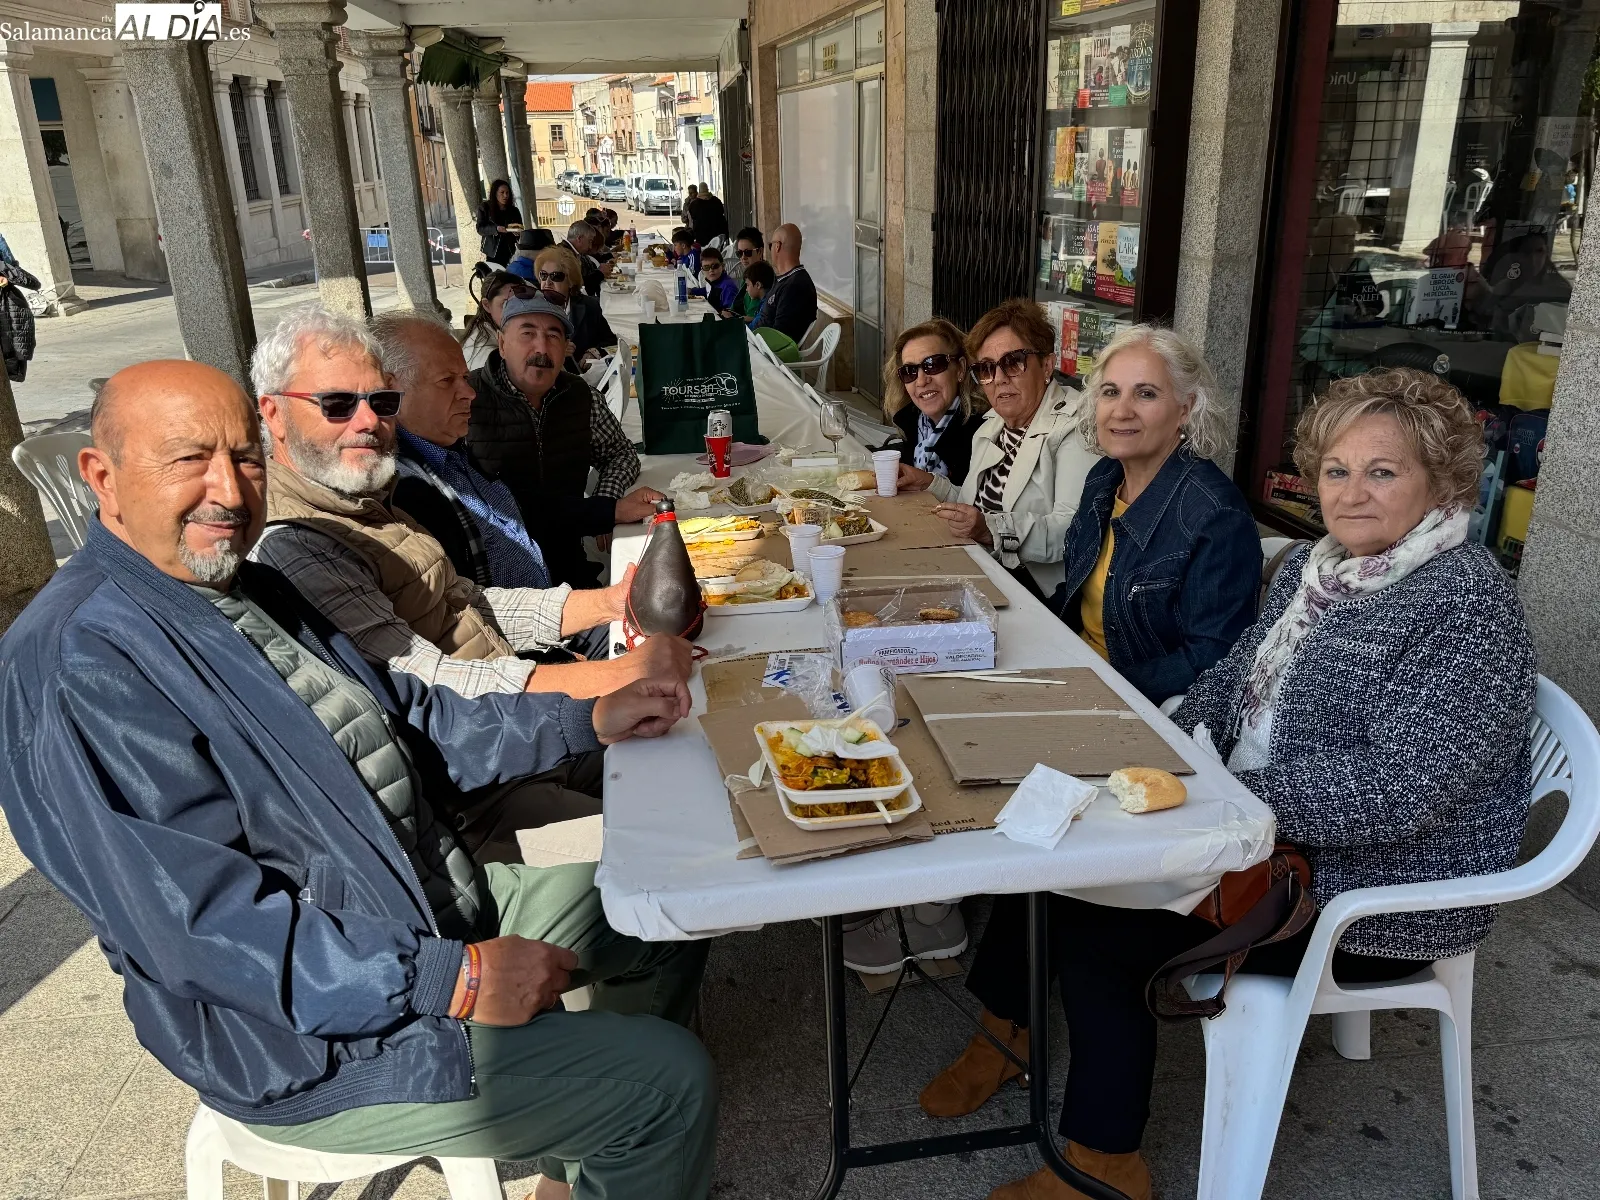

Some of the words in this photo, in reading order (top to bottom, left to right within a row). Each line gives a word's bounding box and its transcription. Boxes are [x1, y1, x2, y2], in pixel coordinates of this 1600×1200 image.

[1362, 285, 1379, 293] KEN
[919, 655, 936, 665] Hijos
[930, 819, 951, 828] ked
[954, 817, 976, 825] and
